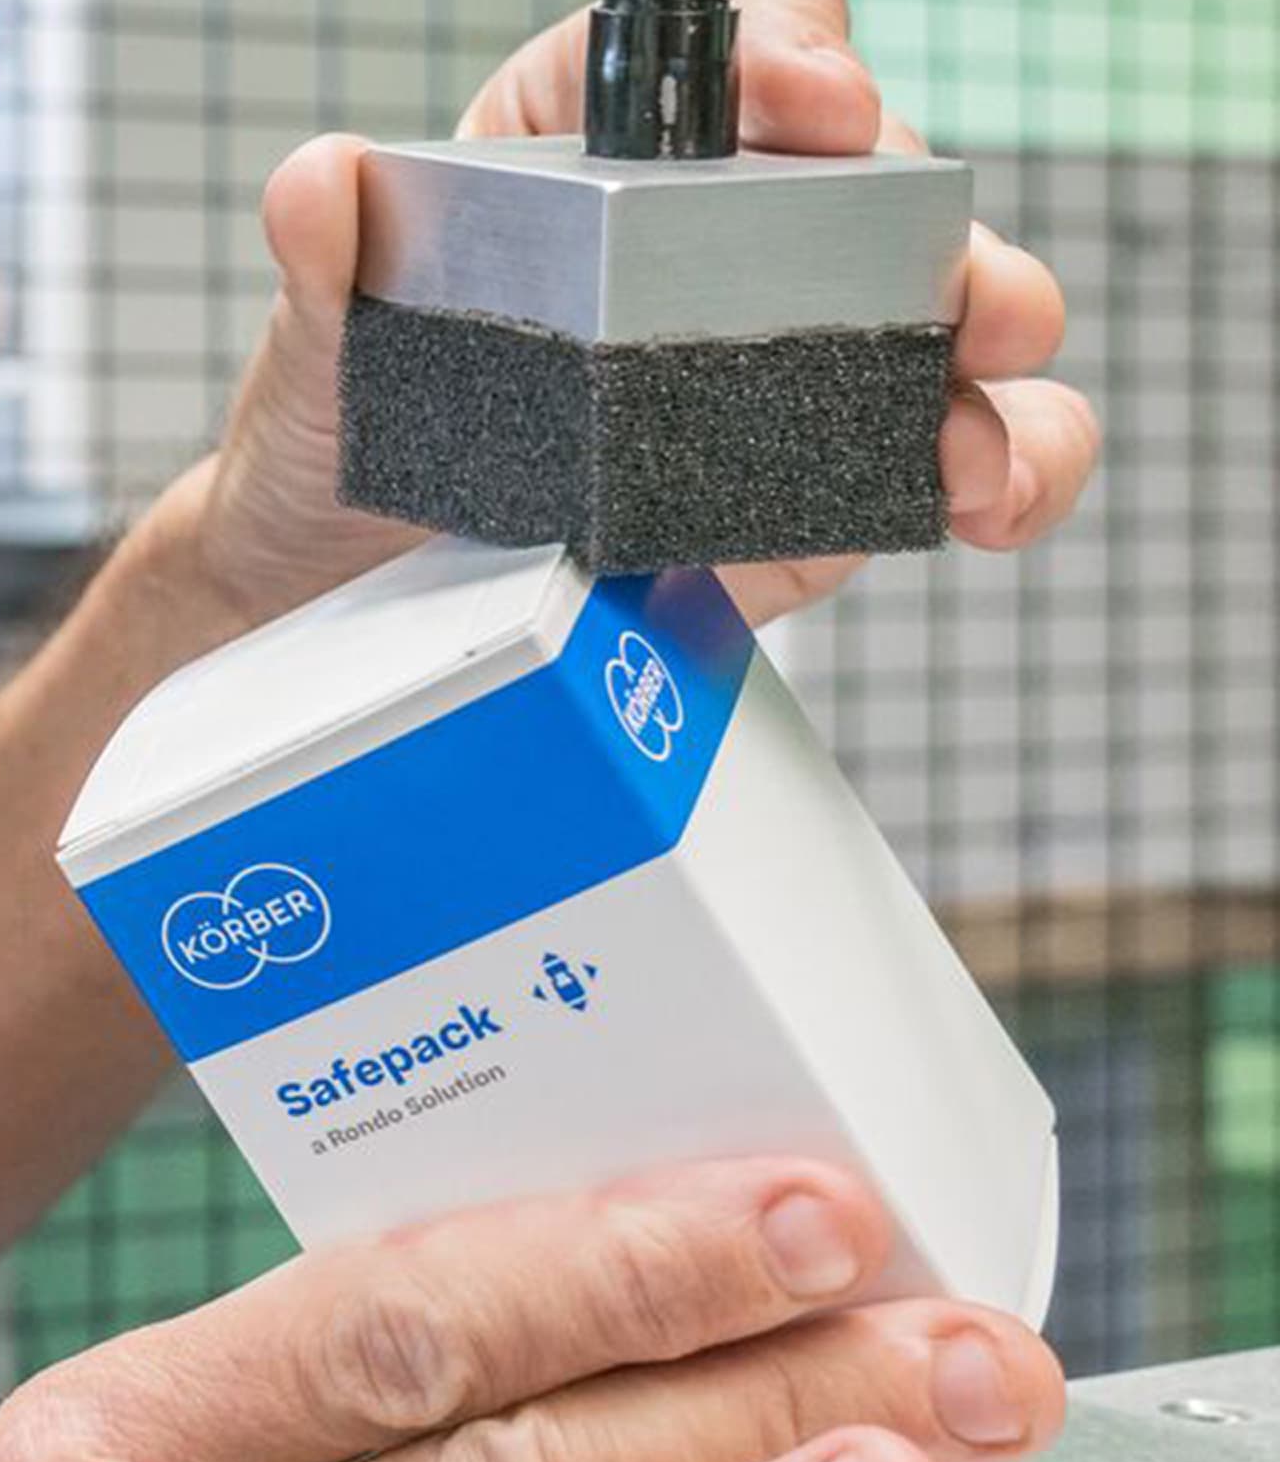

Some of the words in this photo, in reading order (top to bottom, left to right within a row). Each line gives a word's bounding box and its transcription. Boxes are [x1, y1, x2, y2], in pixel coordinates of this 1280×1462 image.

[177, 889, 316, 964] KÖRBER
[276, 1004, 504, 1118] Safepack
[310, 1138, 328, 1156] a
[326, 1108, 404, 1149] Rondo
[403, 1064, 507, 1117] Solution
